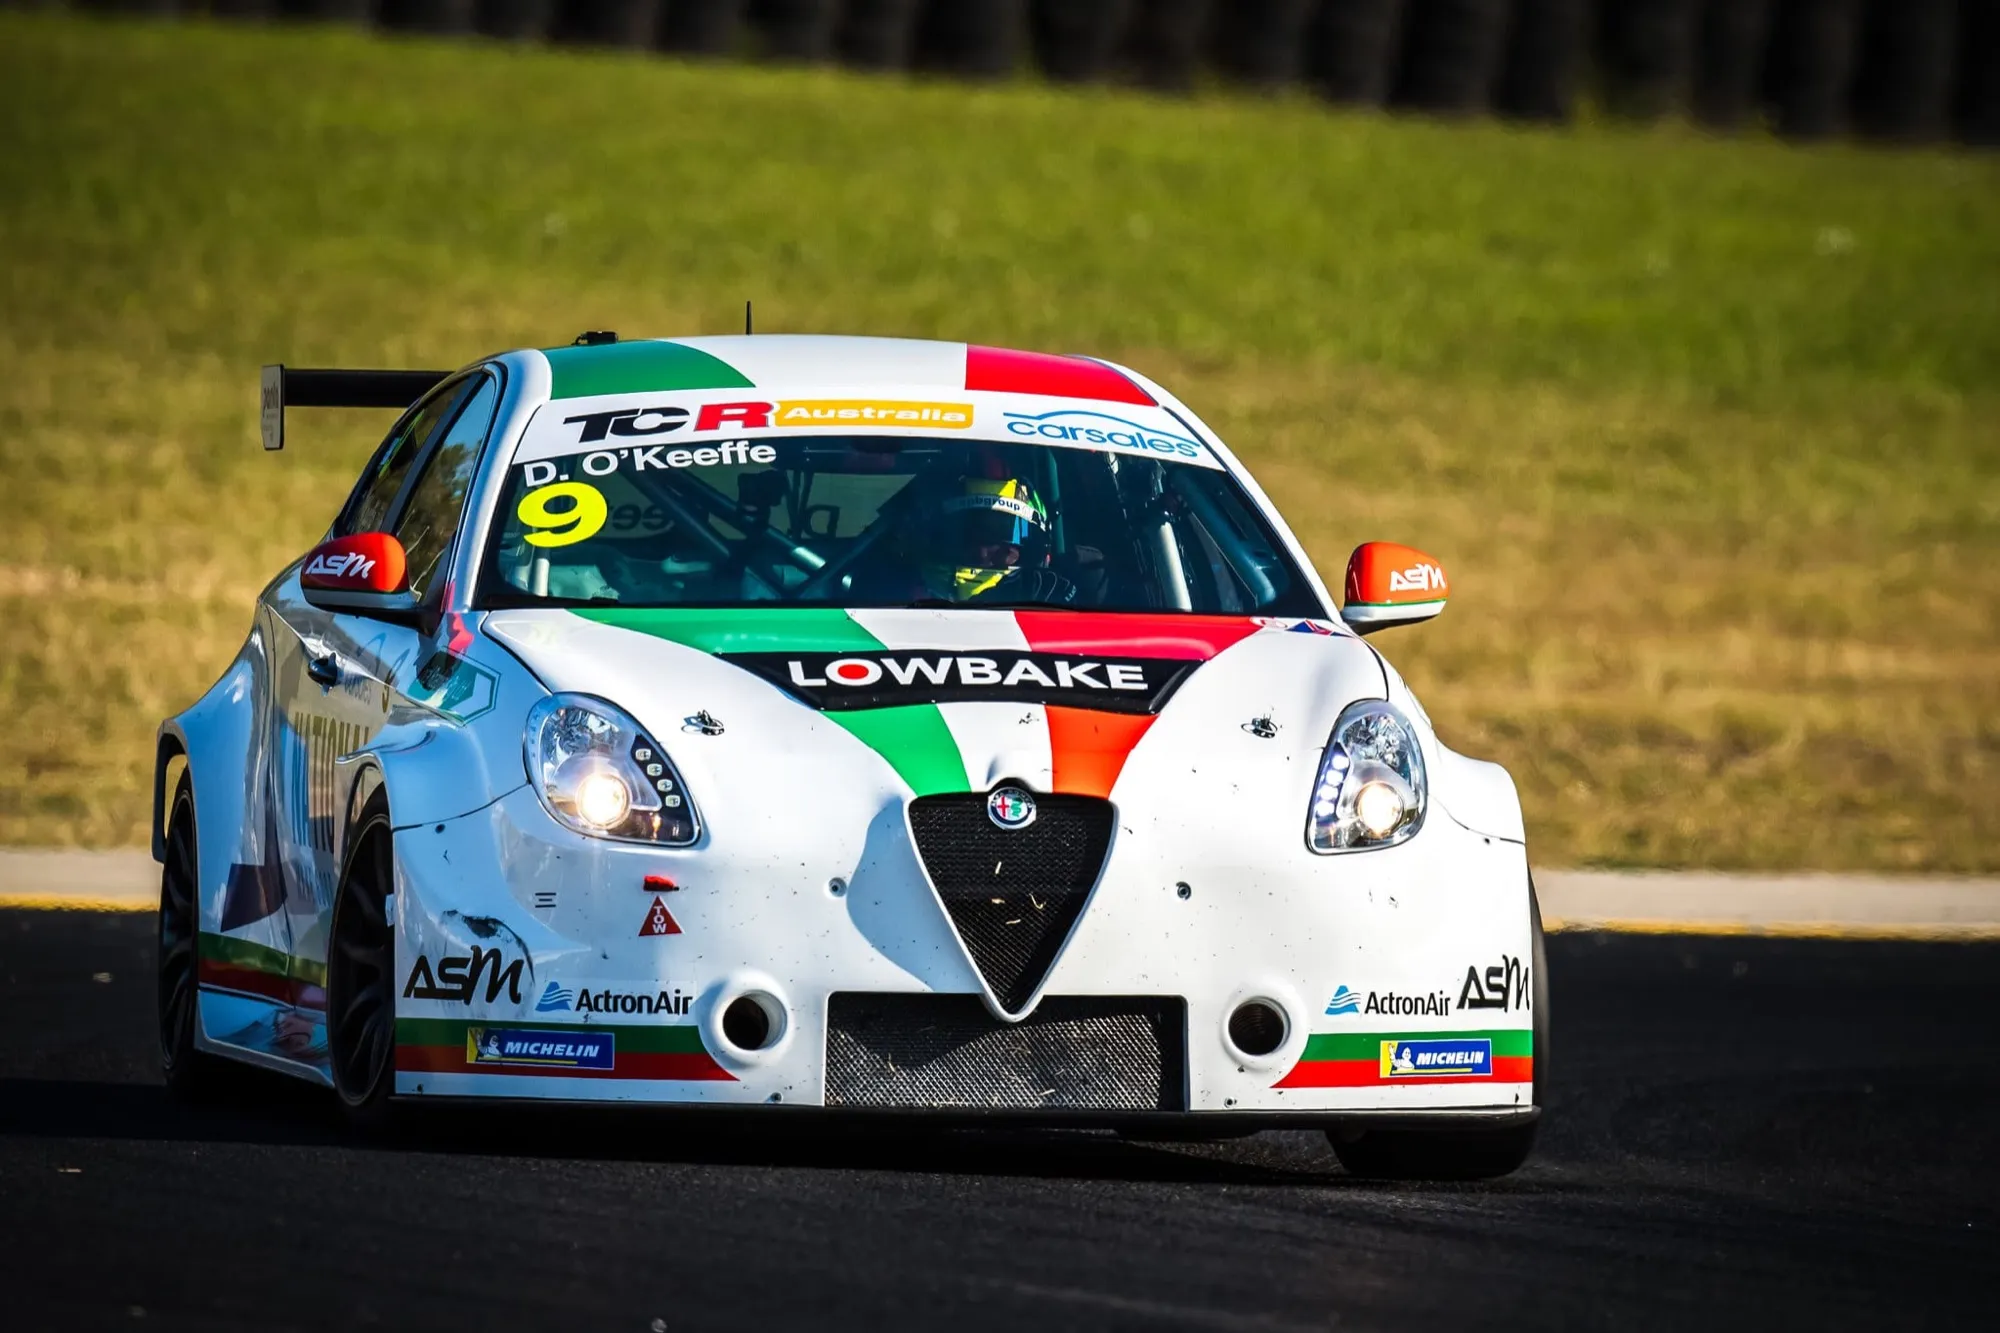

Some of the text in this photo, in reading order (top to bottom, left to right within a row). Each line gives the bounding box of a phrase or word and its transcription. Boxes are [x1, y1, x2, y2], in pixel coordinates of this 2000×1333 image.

[563, 402, 967, 443] TCR Australia
[1007, 420, 1198, 458] carsales
[523, 461, 569, 488] D.
[517, 482, 608, 547] 9
[305, 552, 376, 579] ASM
[1389, 563, 1446, 592] ASM
[788, 657, 1149, 690] LOWBAKE
[653, 905, 667, 934] TOW
[403, 945, 525, 1005] ASM
[1456, 954, 1530, 1013] ASM
[575, 988, 693, 1015] ActronAir
[1364, 990, 1451, 1017] ActronAir
[504, 1040, 600, 1058] MICHELIN
[1416, 1050, 1485, 1066] MICHELIN
